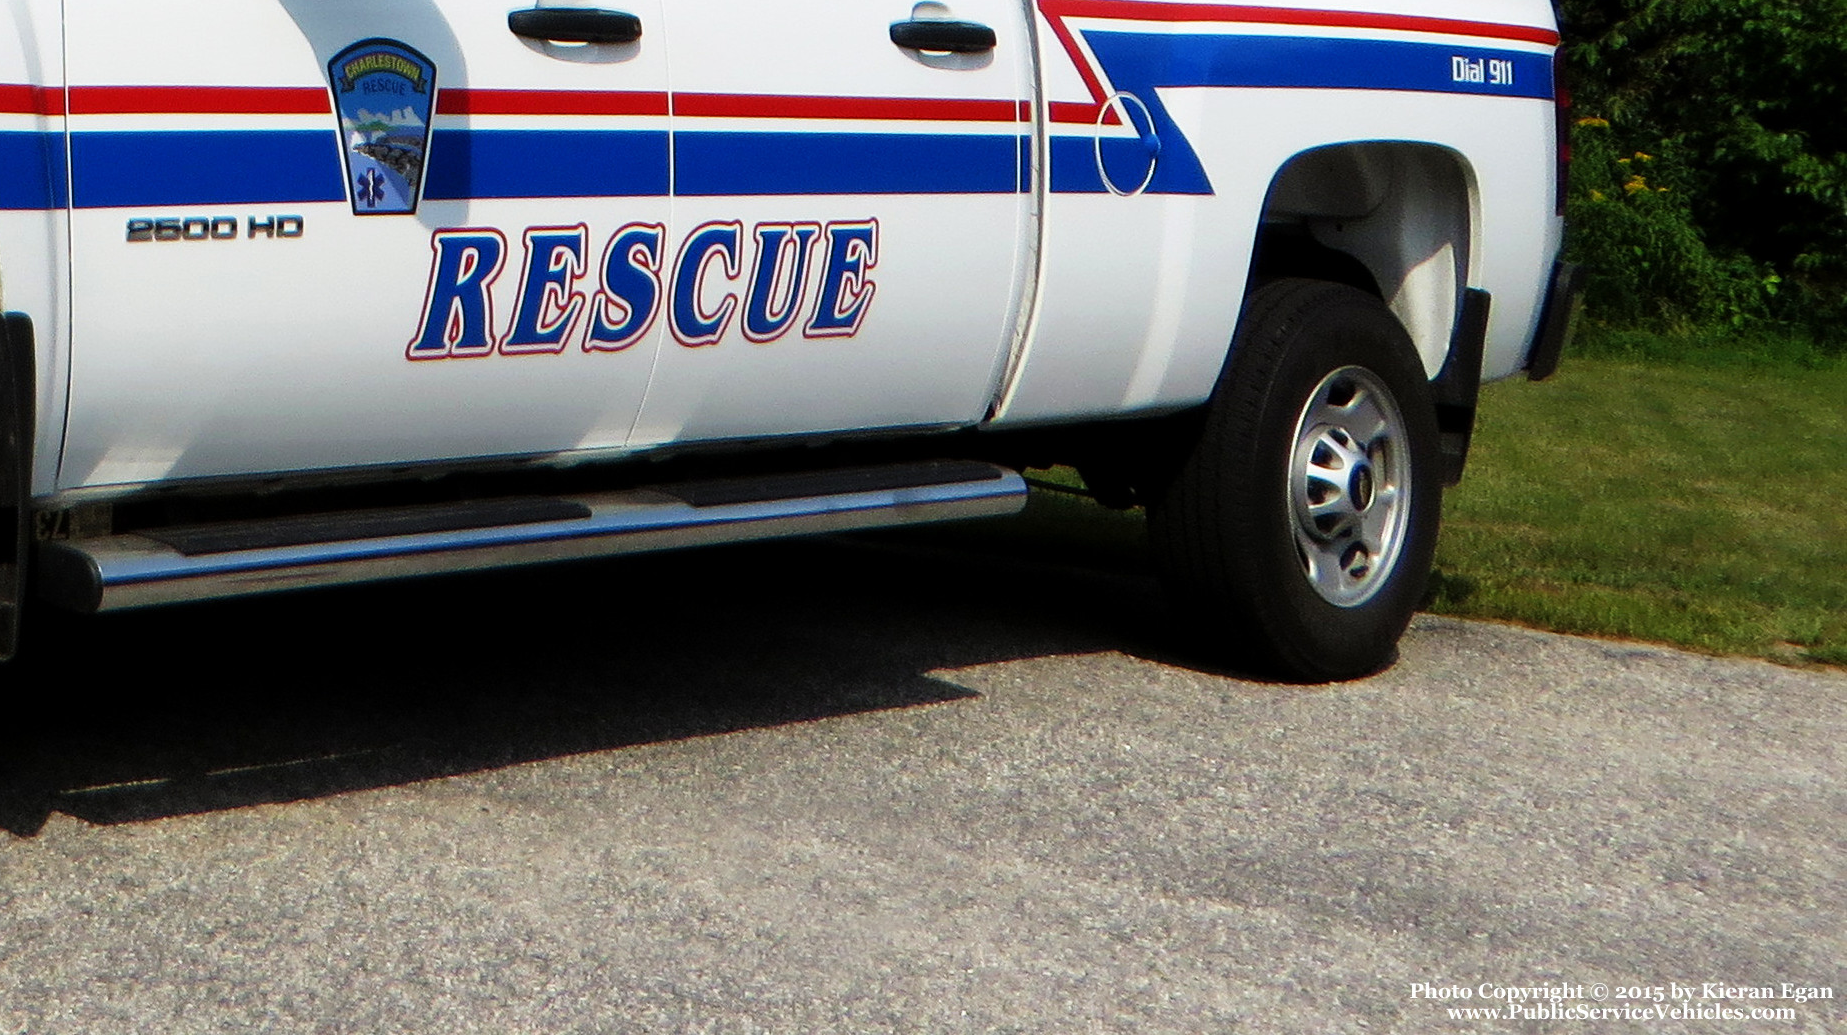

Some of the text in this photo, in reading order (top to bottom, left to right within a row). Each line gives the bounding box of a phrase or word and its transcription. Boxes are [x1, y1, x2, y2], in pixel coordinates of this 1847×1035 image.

[344, 52, 421, 80] CHARLESTOWN
[1452, 56, 1513, 85] Dial 911
[363, 77, 407, 96] RESCUE
[126, 214, 305, 242] 2500 HD
[406, 217, 879, 361] RESCUE
